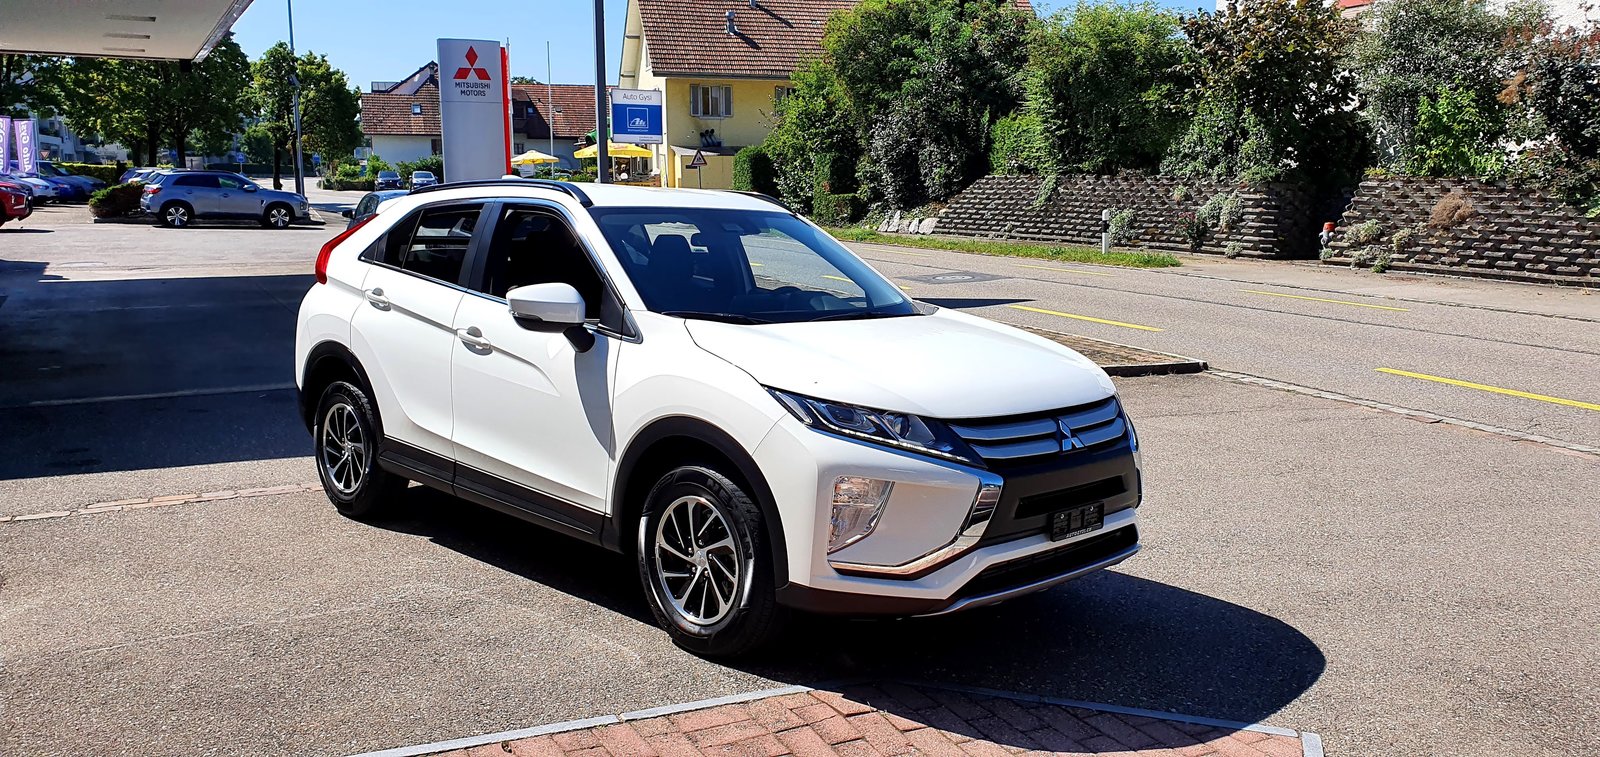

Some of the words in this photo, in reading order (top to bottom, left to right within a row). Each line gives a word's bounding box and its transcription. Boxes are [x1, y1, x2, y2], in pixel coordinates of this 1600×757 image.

[455, 82, 490, 90] MITSUBISHI
[622, 93, 638, 101] Auto
[639, 94, 653, 102] Gysi
